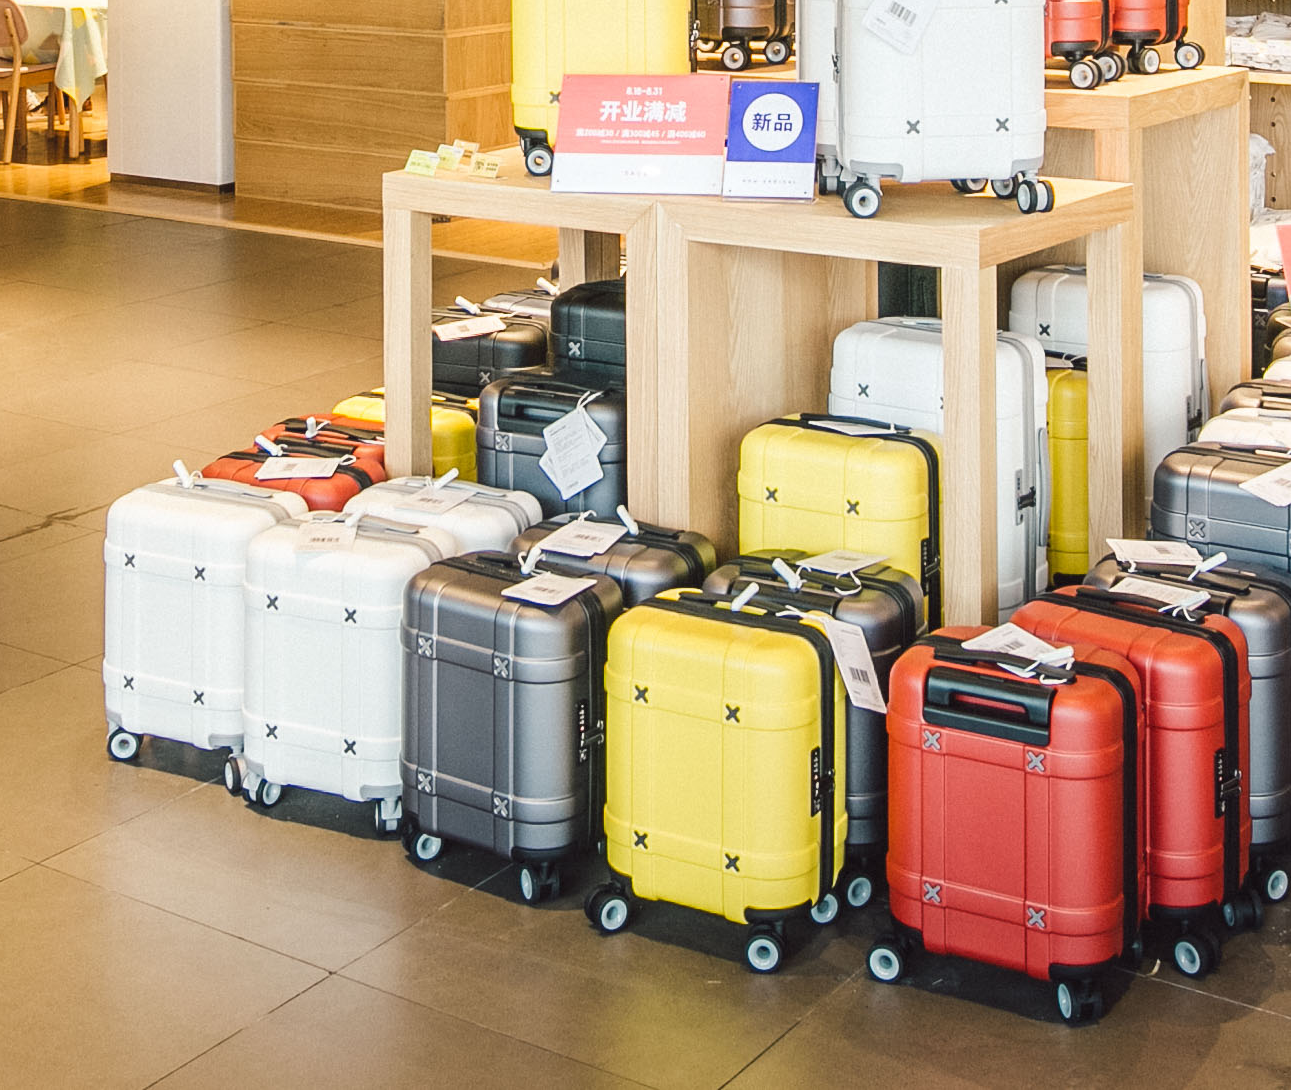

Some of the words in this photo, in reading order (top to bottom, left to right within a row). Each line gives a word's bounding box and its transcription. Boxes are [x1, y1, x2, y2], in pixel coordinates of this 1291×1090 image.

[599, 100, 687, 123] 开业满减
[751, 112, 794, 133] 新品
